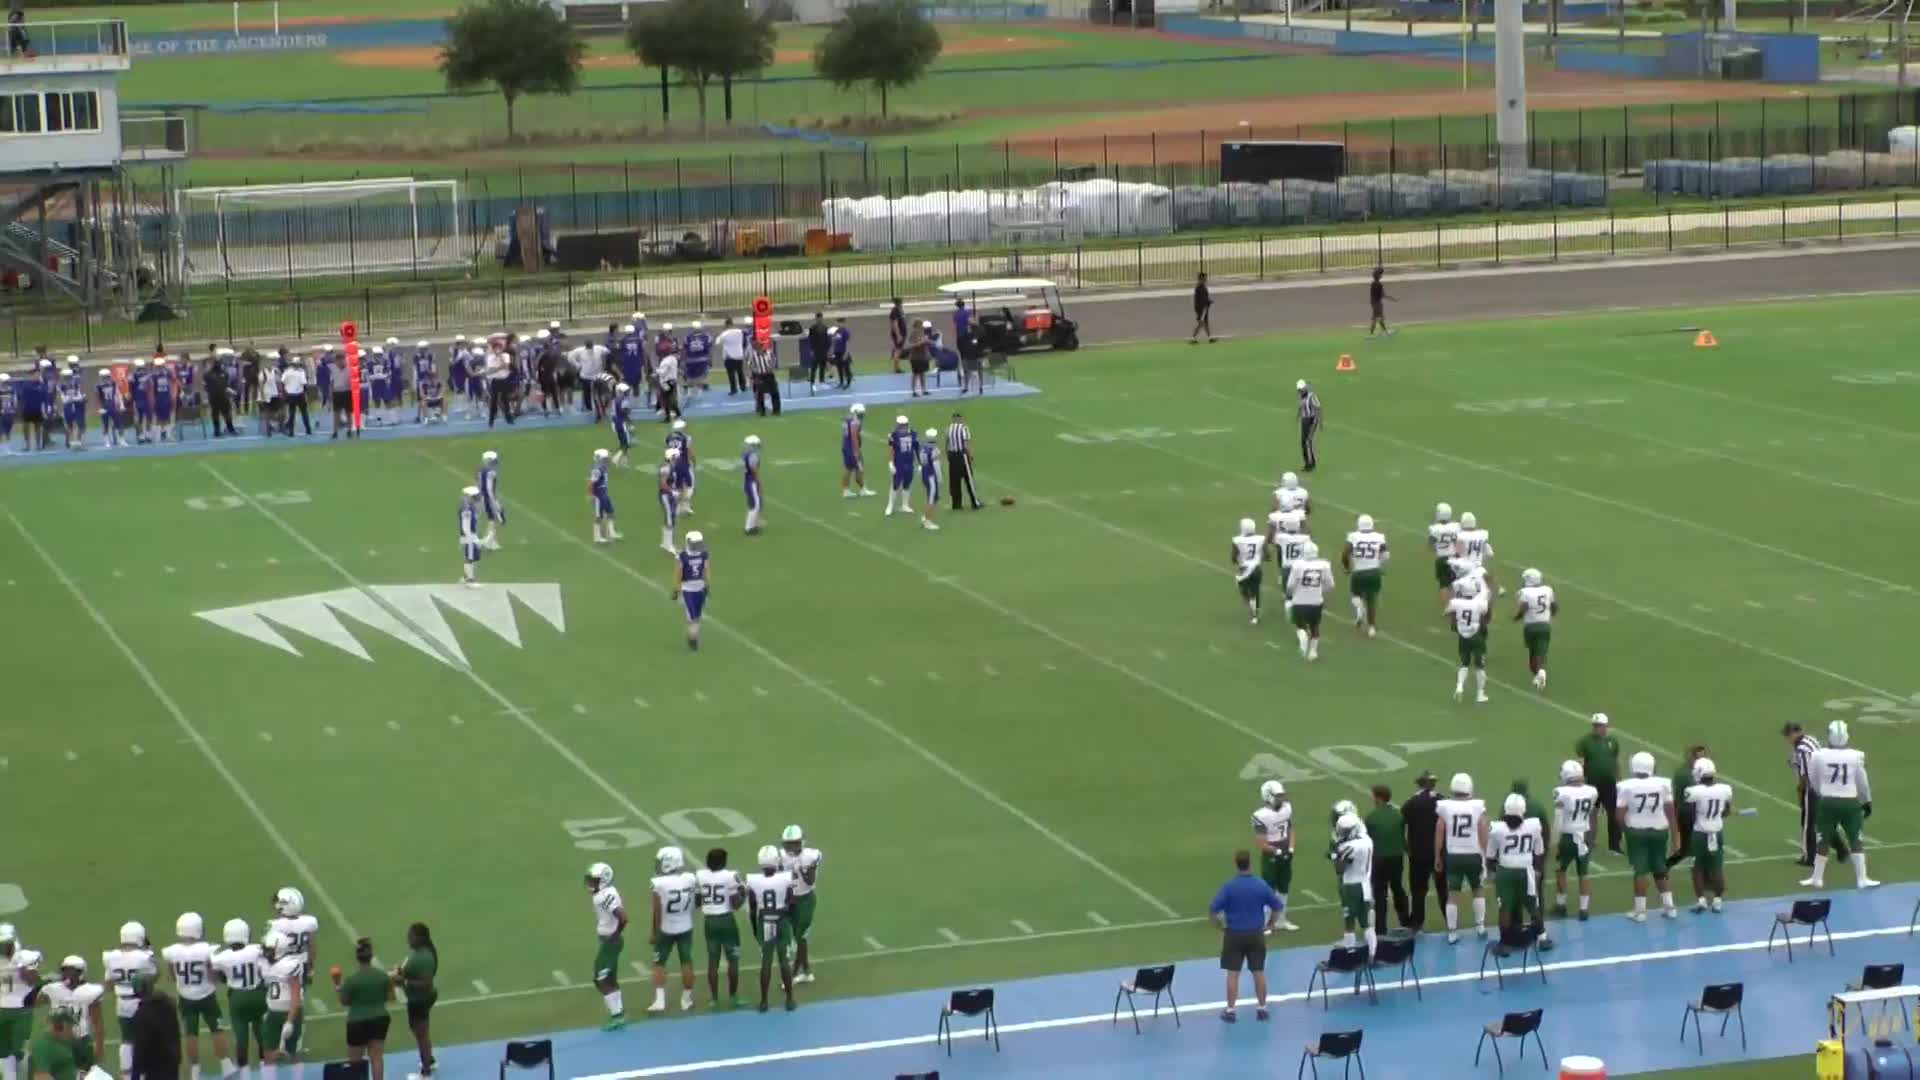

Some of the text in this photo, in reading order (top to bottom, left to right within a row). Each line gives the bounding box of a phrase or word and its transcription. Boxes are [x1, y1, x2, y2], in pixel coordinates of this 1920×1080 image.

[157, 39, 180, 53] OF
[185, 38, 218, 52] THE
[1352, 541, 1377, 559] 55
[1536, 595, 1547, 614] 5
[1461, 609, 1472, 626] 9
[1239, 743, 1409, 781] 40
[1826, 762, 1848, 785] 71
[1572, 798, 1592, 821] 19
[1633, 792, 1660, 813] 77
[1706, 799, 1720, 819] 11
[562, 806, 758, 850] 50
[1452, 814, 1472, 838] 12
[666, 887, 695, 914] 27
[701, 884, 725, 905] 26
[763, 889, 776, 909] 8
[175, 961, 204, 985] 45
[232, 963, 255, 987] 41
